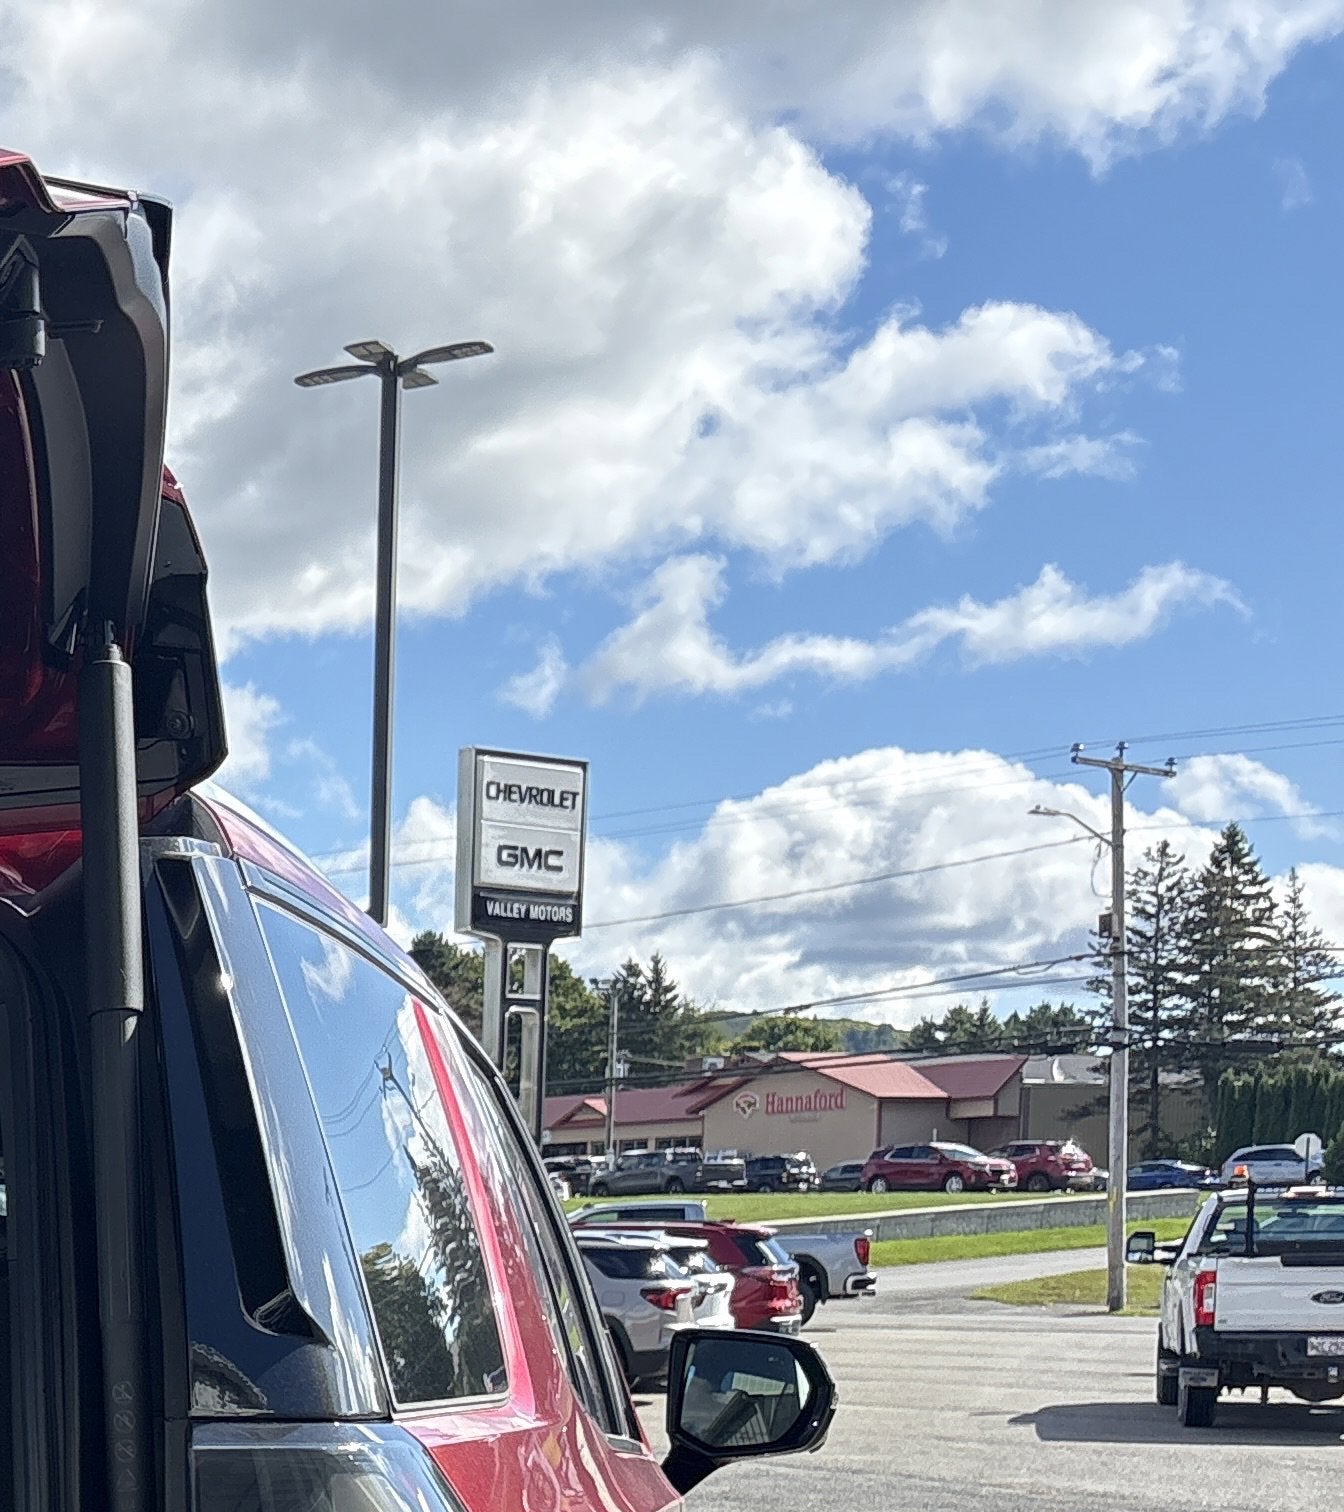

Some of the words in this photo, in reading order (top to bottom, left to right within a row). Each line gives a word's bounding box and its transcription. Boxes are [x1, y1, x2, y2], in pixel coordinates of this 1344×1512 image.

[485, 780, 580, 811] CHEVROLET
[497, 844, 564, 873] GMC
[486, 900, 527, 919] VALLEY
[529, 904, 573, 923] MOTORS
[765, 1084, 846, 1116] Hannaford
